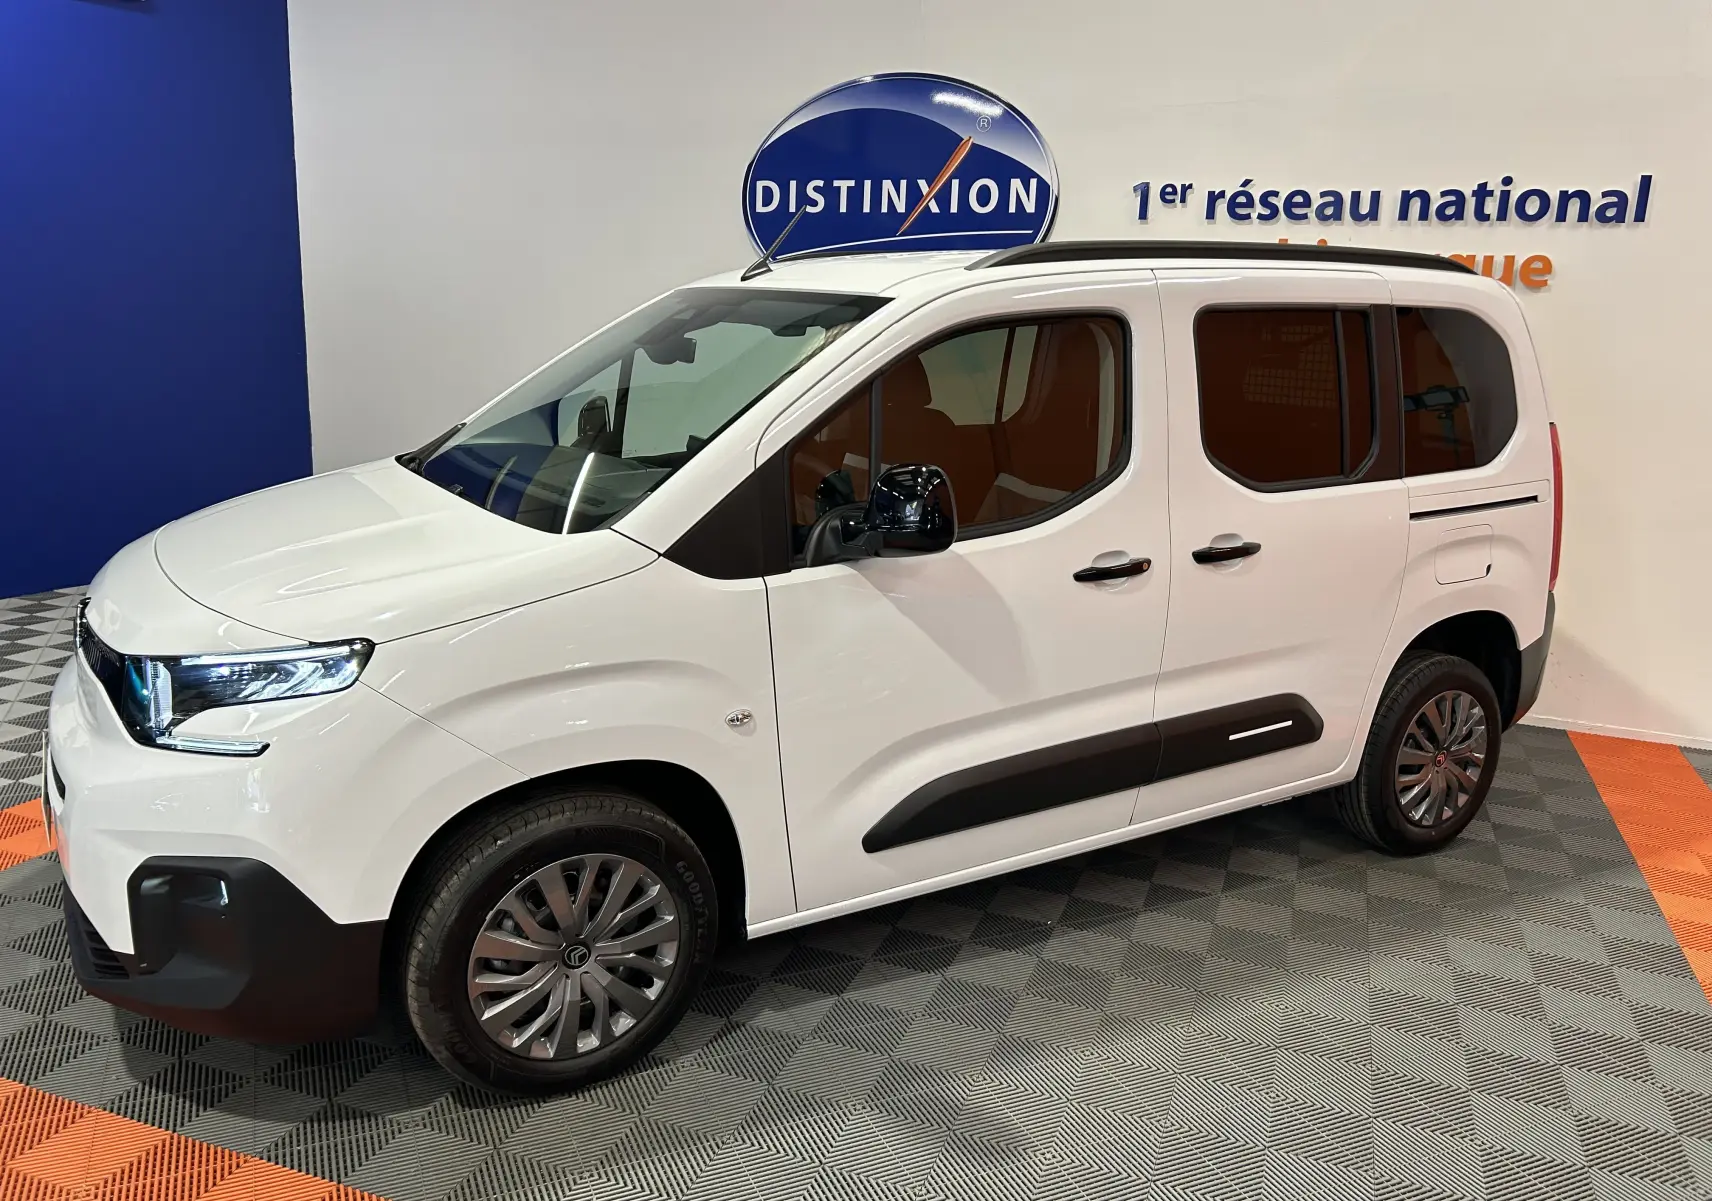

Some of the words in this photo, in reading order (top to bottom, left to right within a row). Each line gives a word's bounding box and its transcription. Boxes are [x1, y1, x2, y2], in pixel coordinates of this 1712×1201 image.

[755, 178, 1038, 214] DISTINXION
[1133, 181, 1193, 220] 1er
[1205, 178, 1381, 222] réseau
[1397, 174, 1653, 224] national
